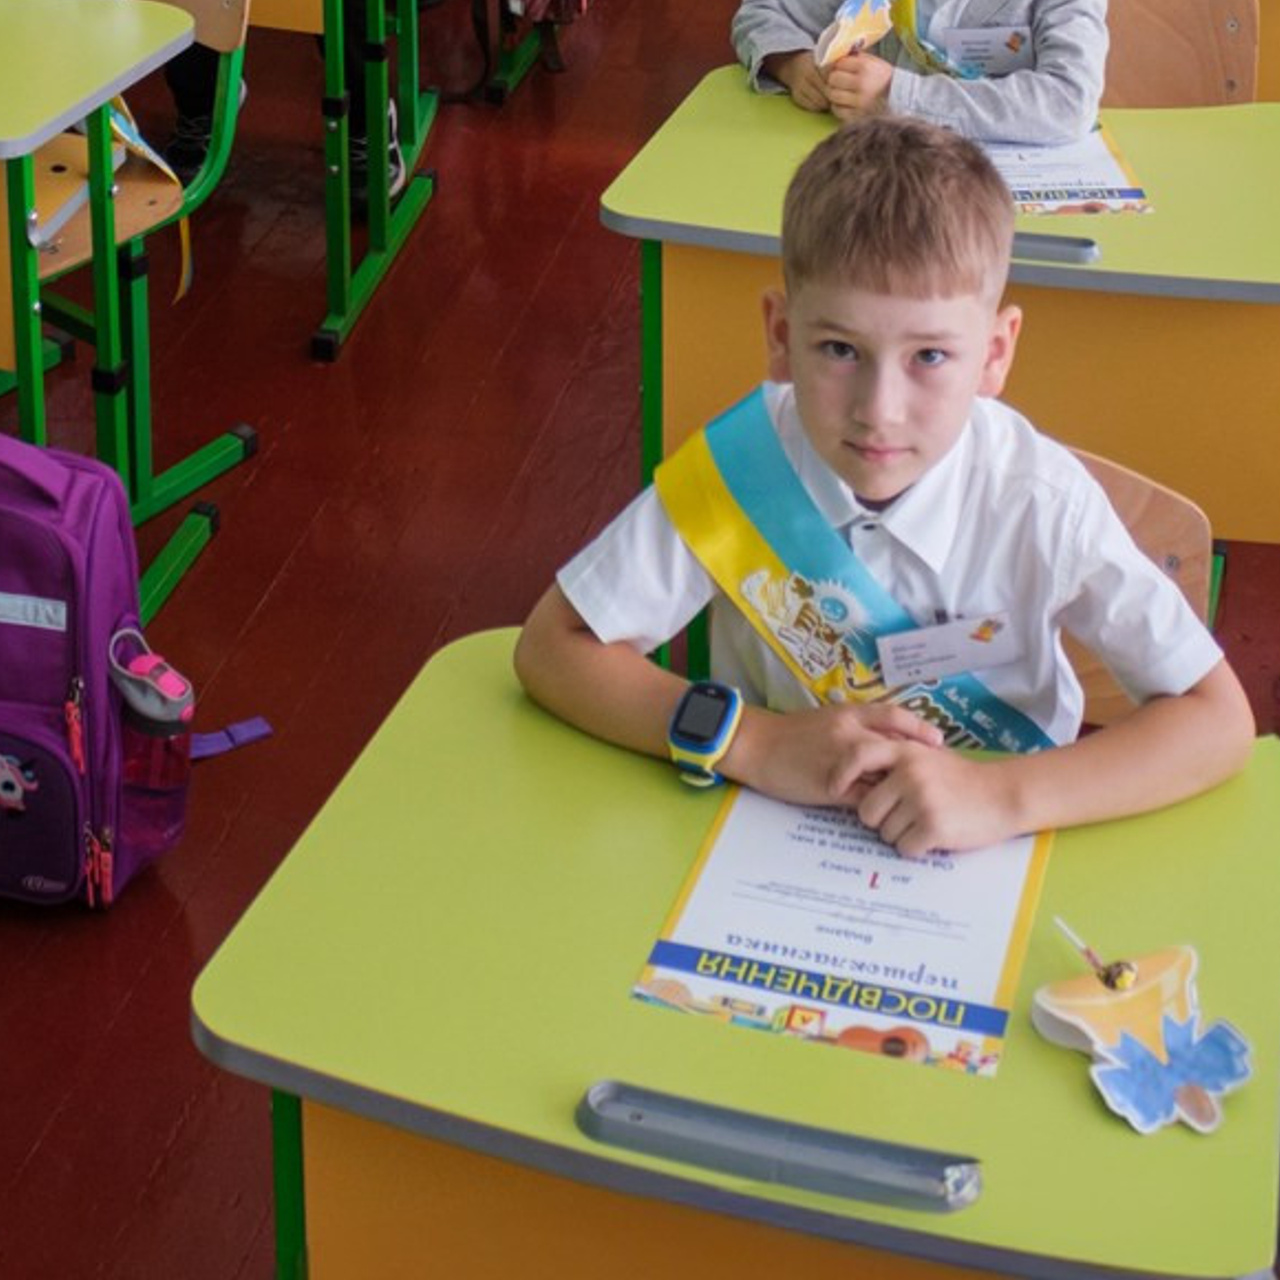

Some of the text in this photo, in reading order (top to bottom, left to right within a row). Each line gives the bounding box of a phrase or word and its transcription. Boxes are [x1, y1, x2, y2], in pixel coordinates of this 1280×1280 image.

[868, 871, 880, 889] 1
[695, 950, 967, 1027] ПОСВІДЧЕННЯ
[726, 933, 960, 991] першокласника
